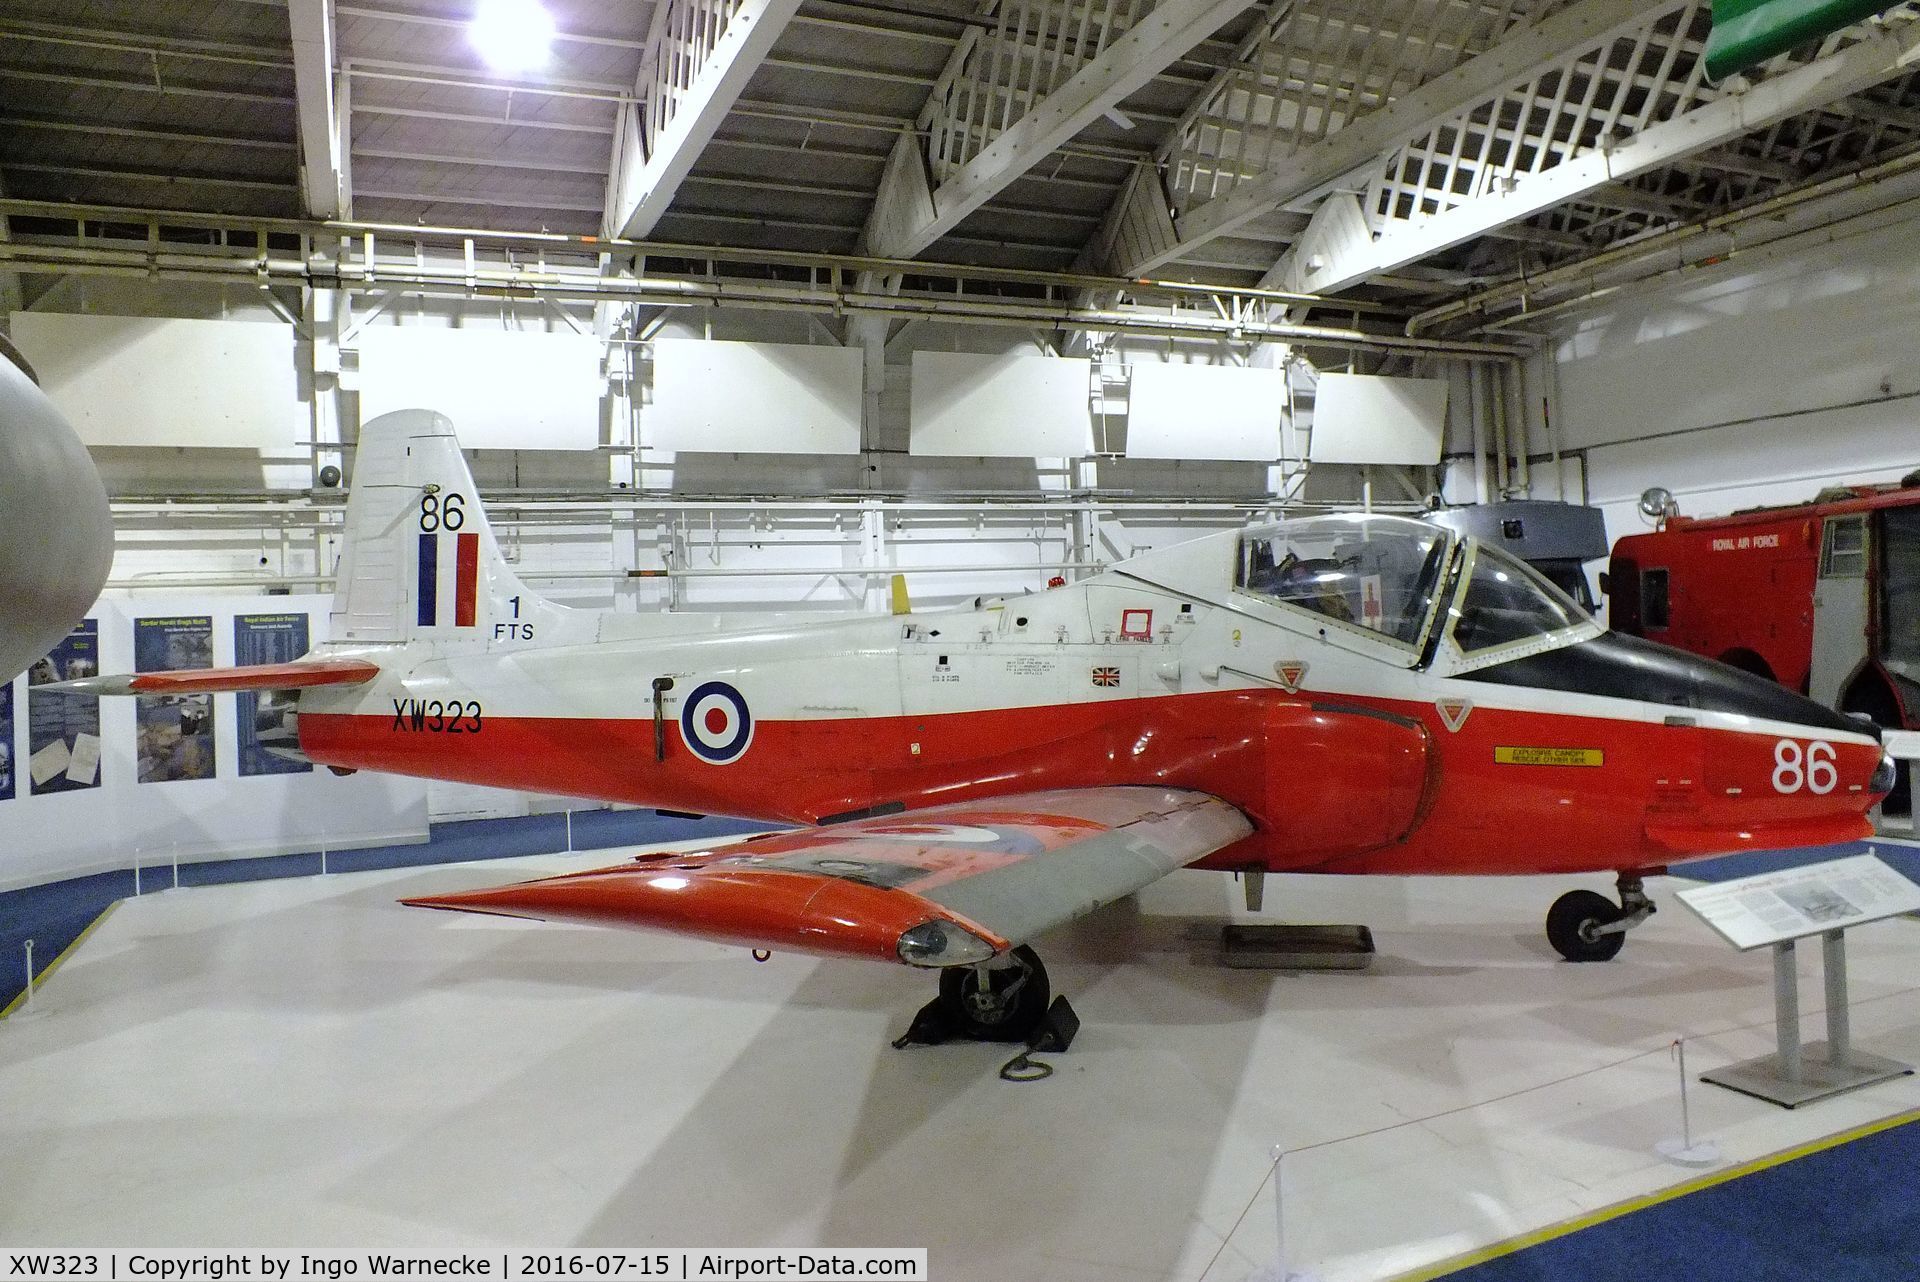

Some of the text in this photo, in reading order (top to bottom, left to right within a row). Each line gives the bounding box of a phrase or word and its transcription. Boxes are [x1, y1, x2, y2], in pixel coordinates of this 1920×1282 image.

[419, 493, 465, 533] 86
[1712, 534, 1780, 552] ROYAL AIR FORCE
[509, 595, 521, 619] 1
[494, 623, 534, 641] FTS
[392, 698, 482, 734] XW323
[1771, 738, 1838, 795] 86
